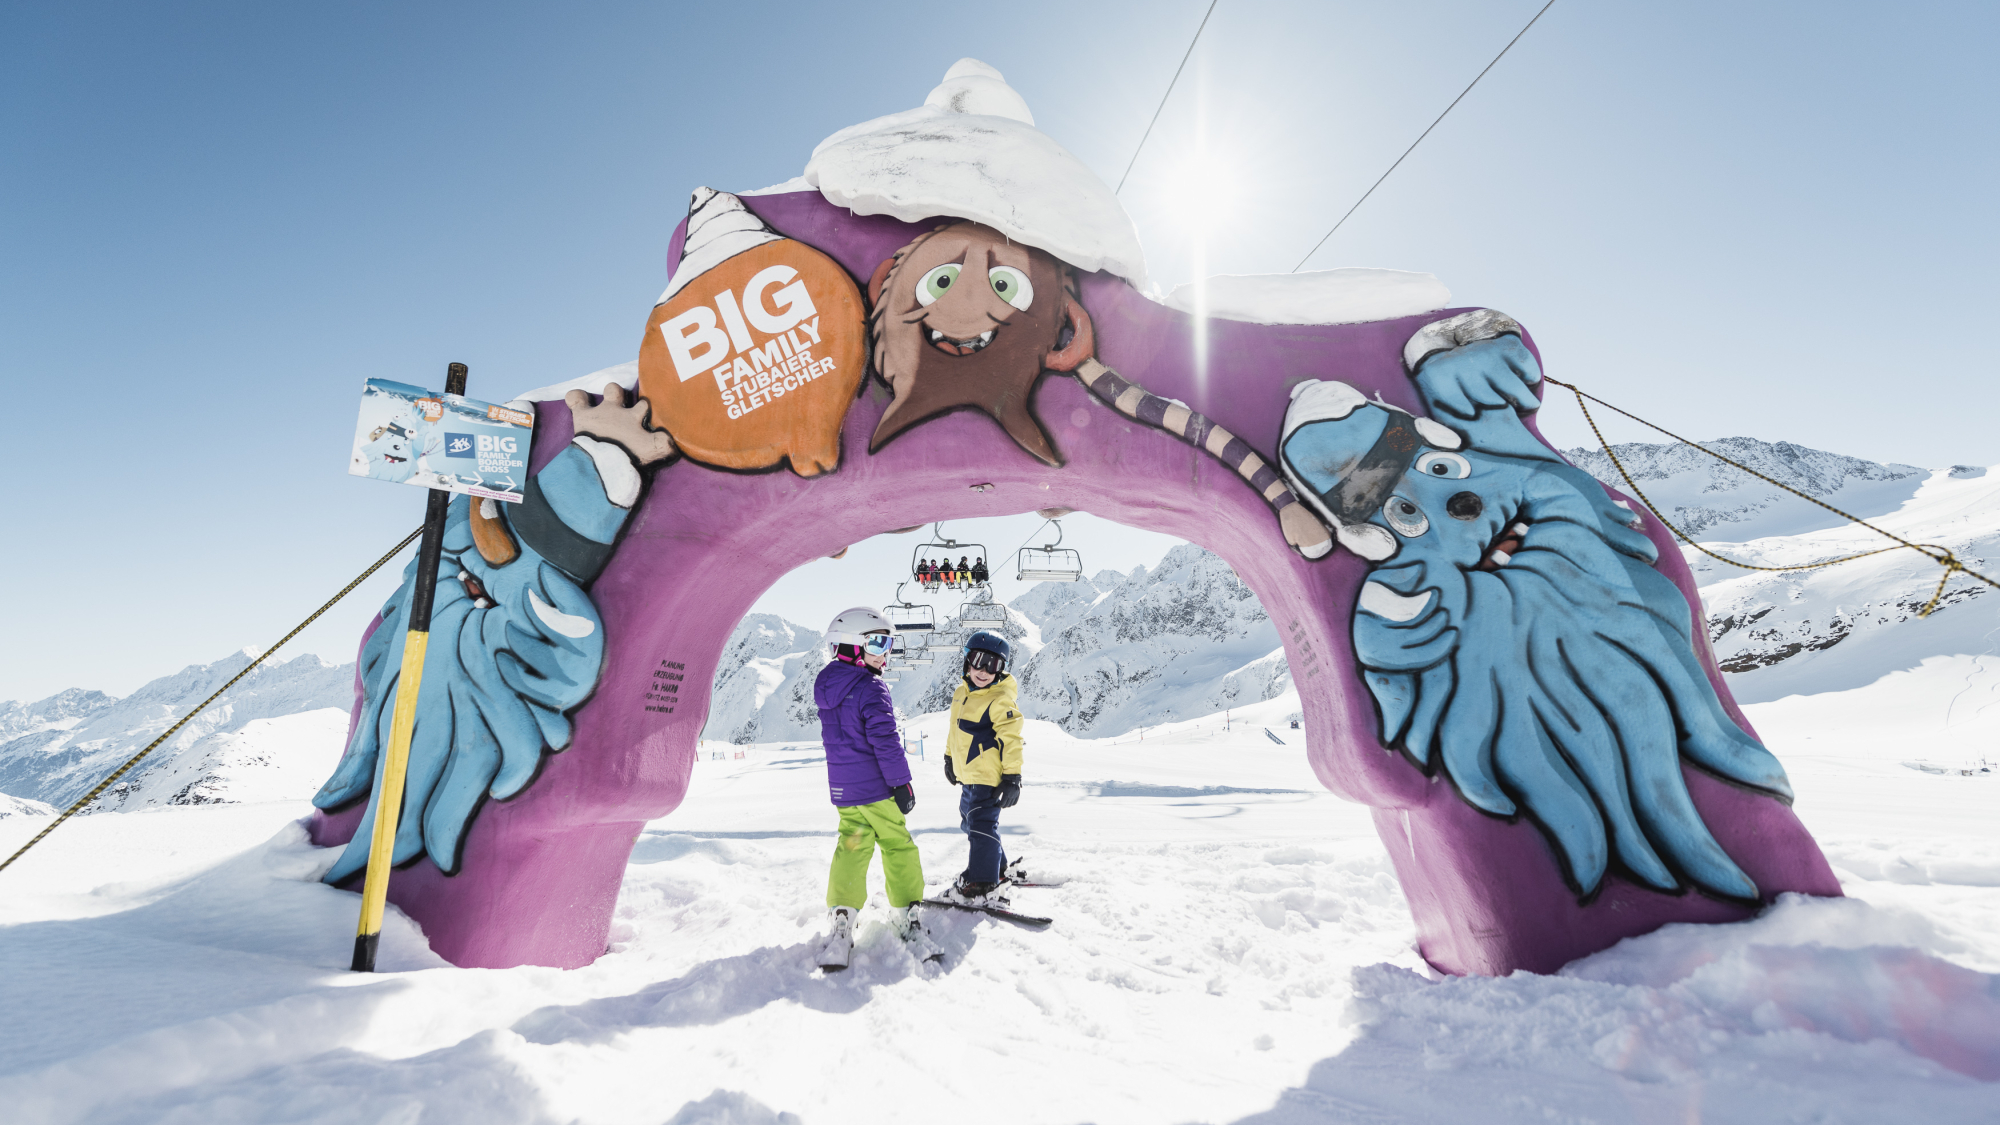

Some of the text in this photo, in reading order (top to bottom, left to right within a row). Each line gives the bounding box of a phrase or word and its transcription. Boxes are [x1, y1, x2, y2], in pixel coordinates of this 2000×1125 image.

[660, 264, 817, 383] BIG
[712, 316, 822, 393] FAMILY
[720, 350, 814, 406] STUBAIER
[727, 356, 836, 420] GLETSCHER
[418, 400, 441, 411] BIG
[498, 414, 531, 425] GLETSCHER
[499, 409, 527, 419] STUBAIER
[477, 434, 518, 453] BIG
[477, 451, 511, 460] FAMILY
[478, 458, 523, 468] BOARDER
[478, 465, 510, 474] CROSS
[661, 660, 685, 671] PLANUNG
